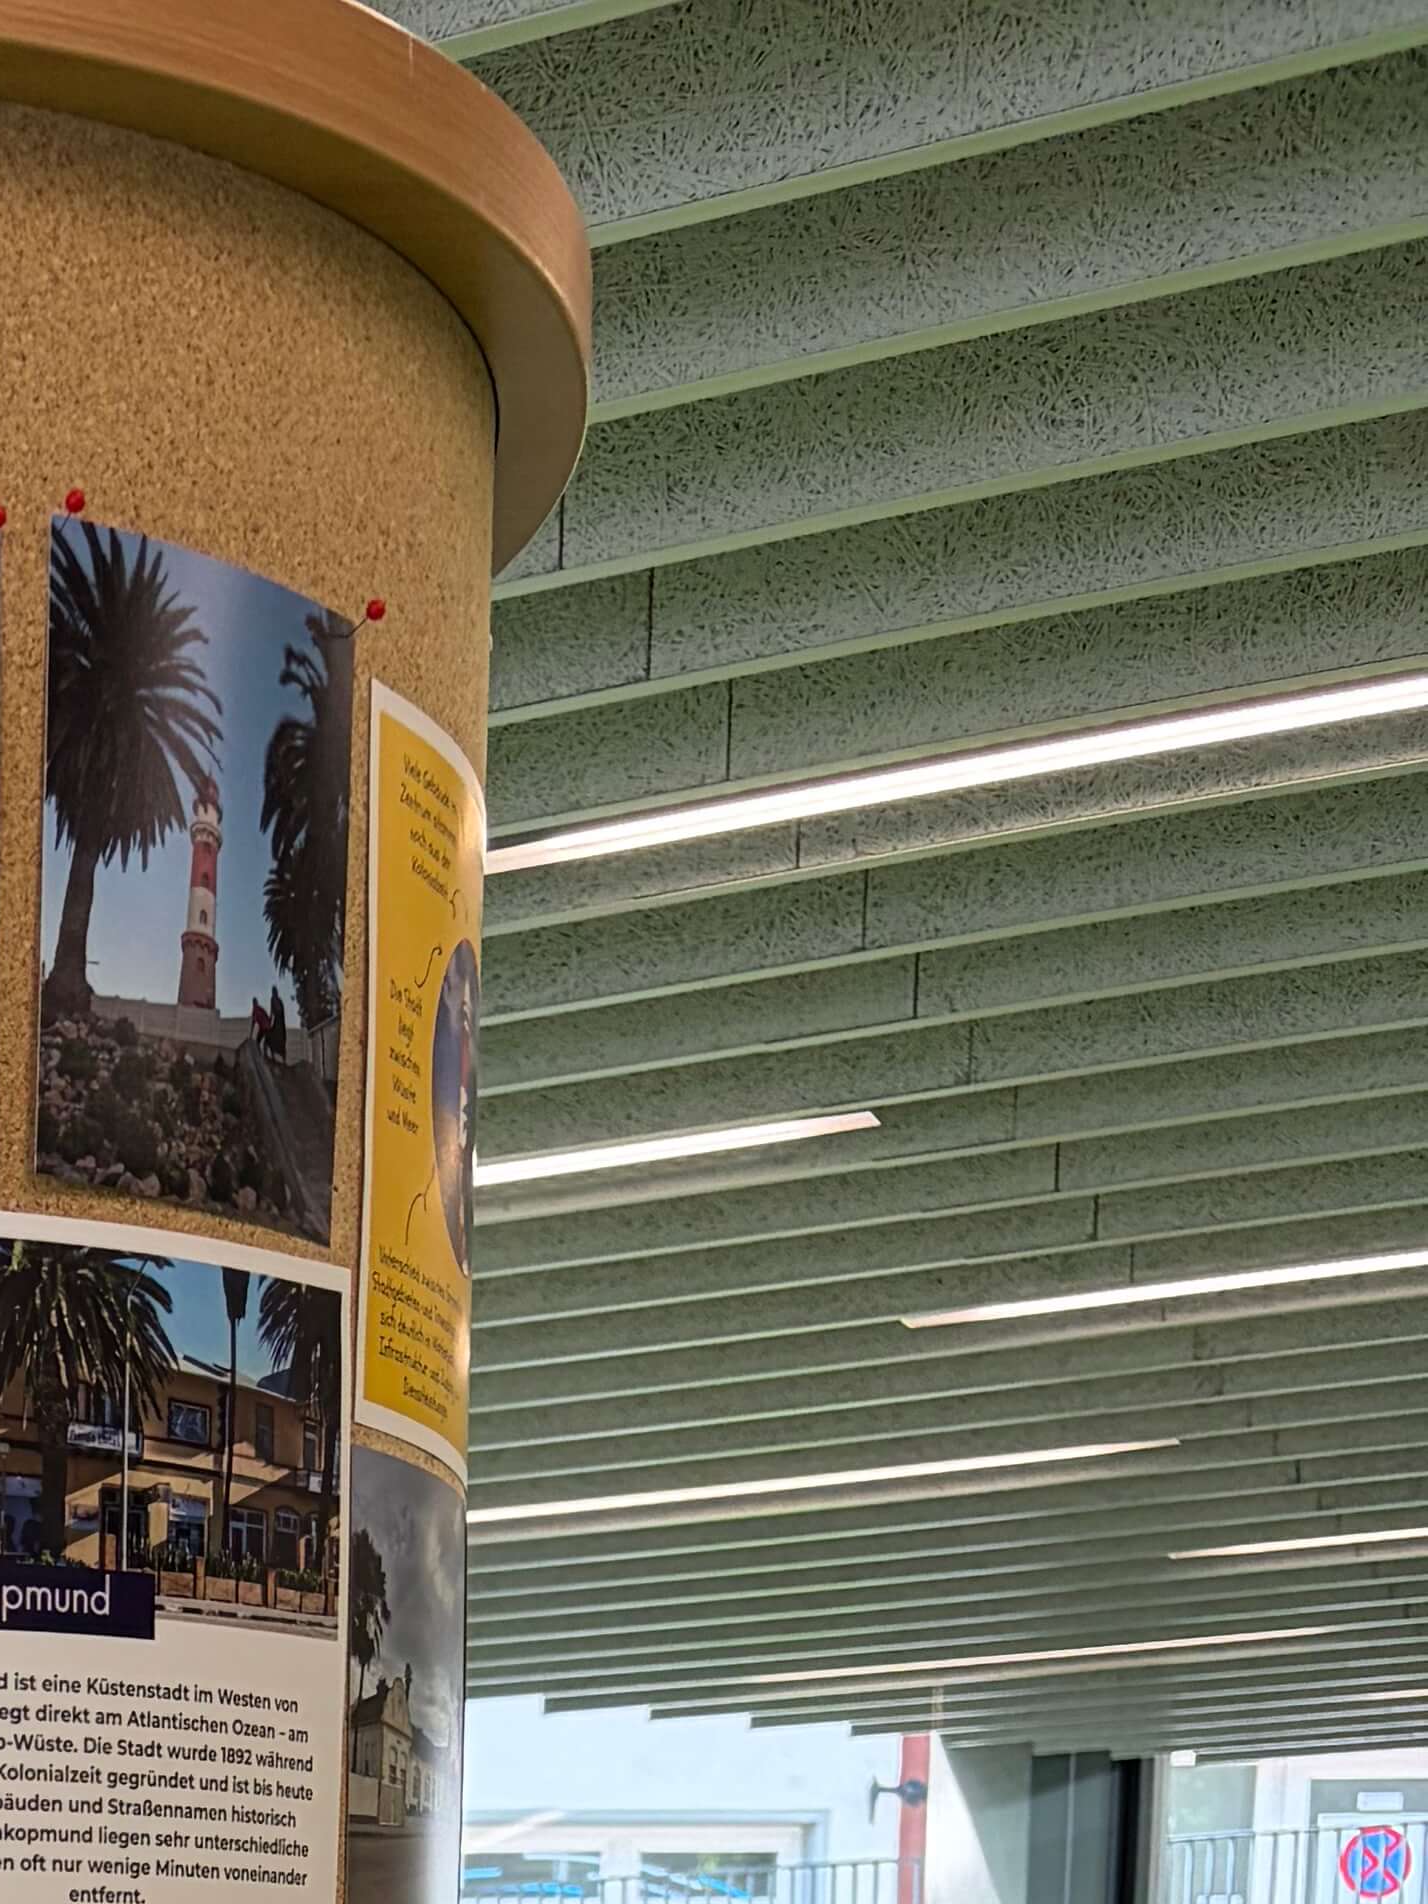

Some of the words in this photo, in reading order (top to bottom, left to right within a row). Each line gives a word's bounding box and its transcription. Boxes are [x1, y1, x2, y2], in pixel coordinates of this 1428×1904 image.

[14, 1671, 37, 1692] ist
[41, 1673, 82, 1694] eine
[87, 1677, 190, 1702] Küstenstadt
[194, 1683, 214, 1704] im
[217, 1688, 272, 1711] Westen
[274, 1697, 299, 1713] von
[35, 1703, 91, 1725] direkt
[95, 1711, 123, 1726] am
[126, 1710, 229, 1735] Atlantischen
[231, 1718, 276, 1740] Ozean
[288, 1728, 309, 1744] am
[83, 1736, 113, 1755] Die
[116, 1738, 163, 1759] Stadt
[166, 1743, 217, 1763] wurde
[220, 1746, 253, 1766] 1892
[255, 1750, 313, 1773] während
[106, 1769, 195, 1791] gegründet
[199, 1775, 229, 1793] und
[232, 1775, 250, 1795] ist
[253, 1777, 273, 1797] bis
[275, 1780, 314, 1801] heute
[68, 1796, 103, 1815] und
[107, 1797, 228, 1822] Straßennamen
[231, 1804, 297, 1829] historisch
[98, 1825, 151, 1849] liegen
[154, 1830, 191, 1849] sehr
[194, 1834, 309, 1858] unterschiedliche
[19, 1853, 47, 1872] oft
[52, 1858, 83, 1873] nur
[87, 1856, 151, 1880] wenige
[155, 1858, 220, 1880] Minuten
[223, 1864, 308, 1886] voneinander
[68, 1885, 146, 1904] entfernt.
